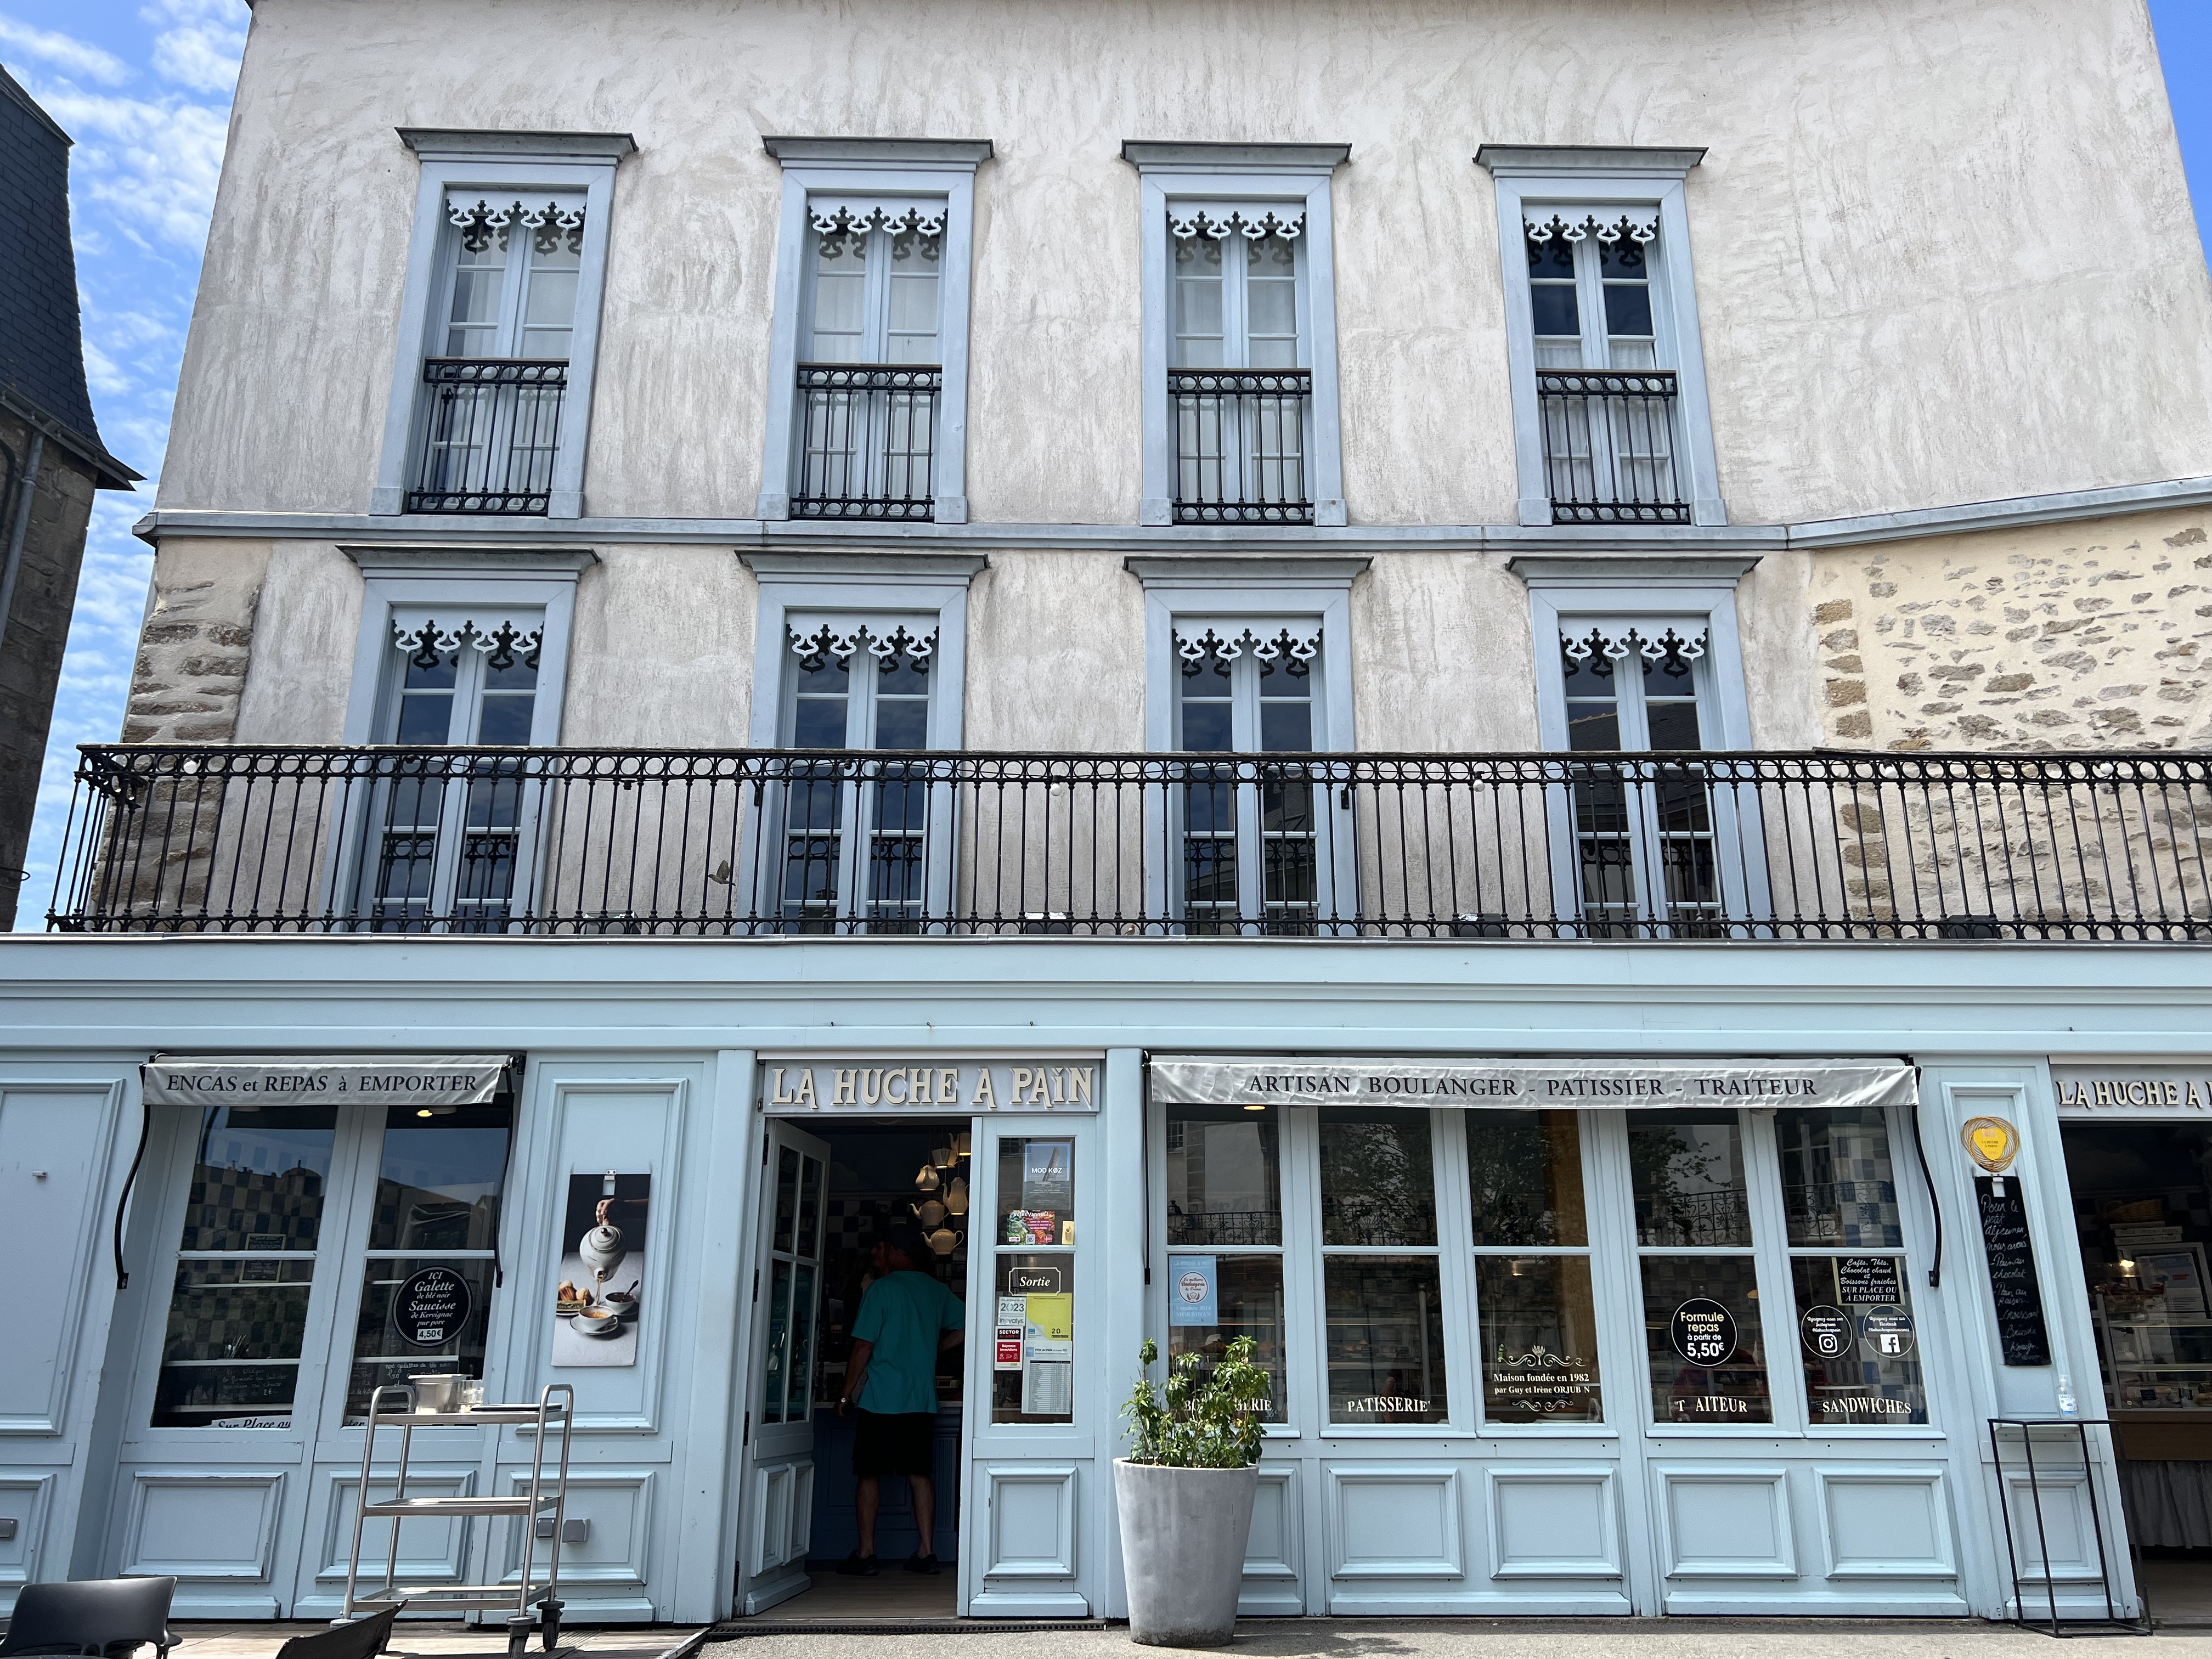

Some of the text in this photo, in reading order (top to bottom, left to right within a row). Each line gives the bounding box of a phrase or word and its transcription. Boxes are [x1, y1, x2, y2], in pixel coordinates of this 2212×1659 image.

[166, 1075, 477, 1091] ENCAS et REPAS à EMPORTER
[769, 1068, 819, 1109] LA
[831, 1066, 958, 1105] HUCHE
[970, 1068, 997, 1109] A
[1249, 1076, 1350, 1093] ARTISAN
[1368, 1077, 1518, 1096] BOULANGER
[1547, 1079, 1664, 1096] PATISSIER
[1694, 1079, 1818, 1096] TRAITEUR
[2056, 1081, 2092, 1109] LA
[2091, 1081, 2179, 1105] HUCHE
[2186, 1081, 2204, 1109] A
[1981, 1194, 2019, 1213] Pour le
[1984, 1214, 2005, 1227] petit
[415, 1280, 455, 1292] Galette
[1019, 1276, 1051, 1286] Sortie
[409, 1300, 456, 1311] Saucisse
[1000, 1302, 1024, 1312] 2023
[419, 1311, 453, 1319] Kervignac
[1680, 1312, 1724, 1322] Formule
[419, 1329, 442, 1339] 4,50€
[1688, 1324, 1719, 1334] repas
[1687, 1342, 1724, 1359] 5,50€
[1493, 1373, 1525, 1382] Maison
[1527, 1373, 1555, 1382] fondée
[1570, 1373, 1589, 1382] 1982
[1509, 1386, 1523, 1395] Guy
[1347, 1396, 1429, 1412] PATISSERIE
[1677, 1396, 1748, 1412] TAITEUR
[1822, 1397, 1912, 1414] SANDWICHES
[244, 1418, 275, 1428] Place
